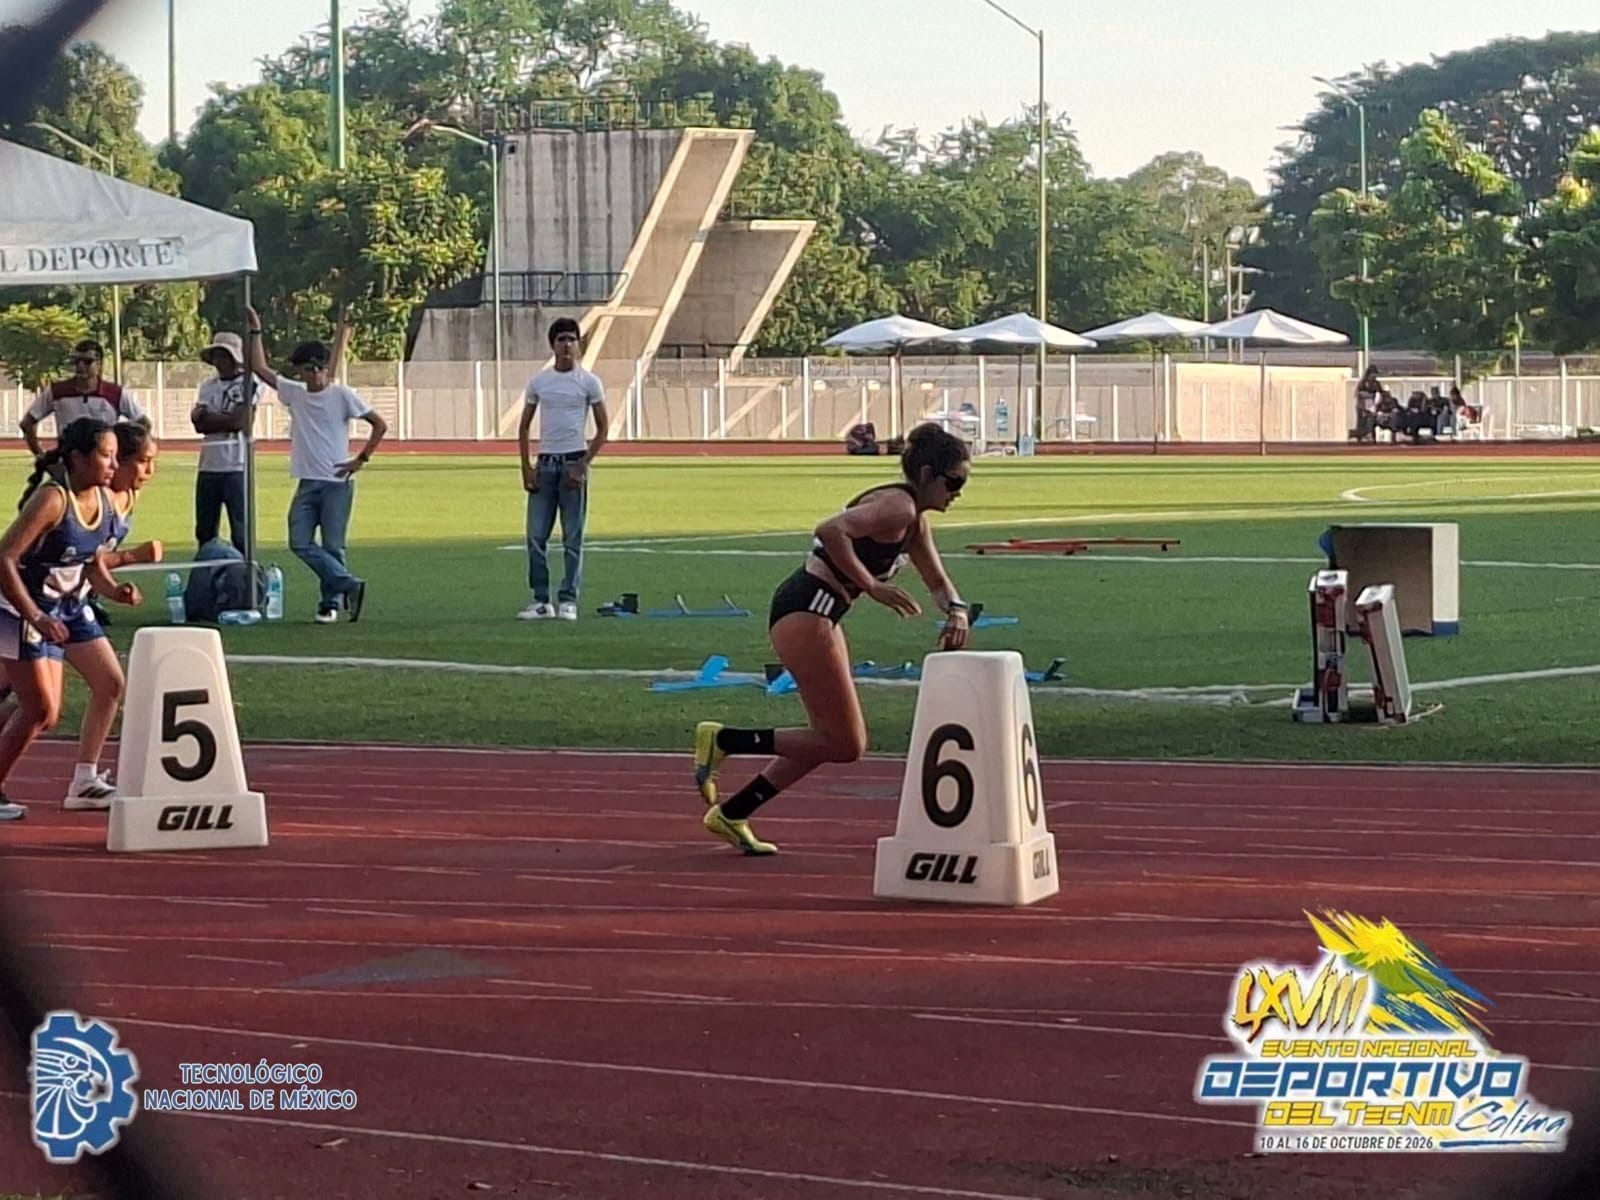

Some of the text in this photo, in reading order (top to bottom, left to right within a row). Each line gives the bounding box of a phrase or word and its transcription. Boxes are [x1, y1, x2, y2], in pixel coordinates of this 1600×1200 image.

[28, 241, 171, 271] DEPORTE
[161, 688, 217, 781] 5
[921, 723, 975, 828] 6
[1021, 723, 1038, 826] 6
[157, 804, 234, 831] GILL
[905, 852, 979, 884] GILL
[1032, 849, 1050, 879] GILL
